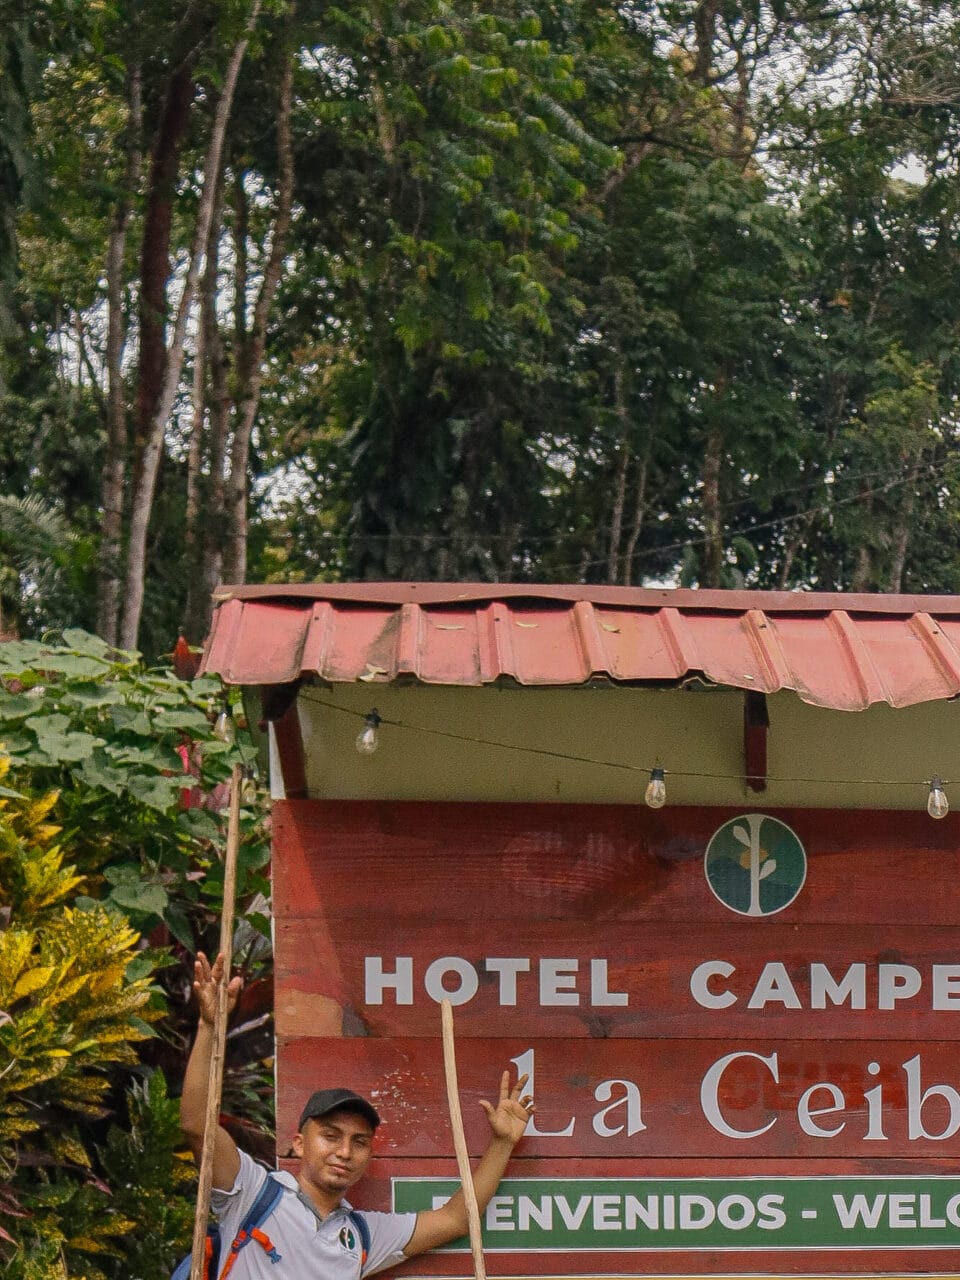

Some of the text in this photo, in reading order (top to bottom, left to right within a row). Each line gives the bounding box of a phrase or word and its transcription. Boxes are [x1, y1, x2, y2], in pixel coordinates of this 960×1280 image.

[364, 956, 629, 1007] HOTEL
[509, 1047, 647, 1138] La
[432, 1193, 786, 1231] ENVENIDOS
